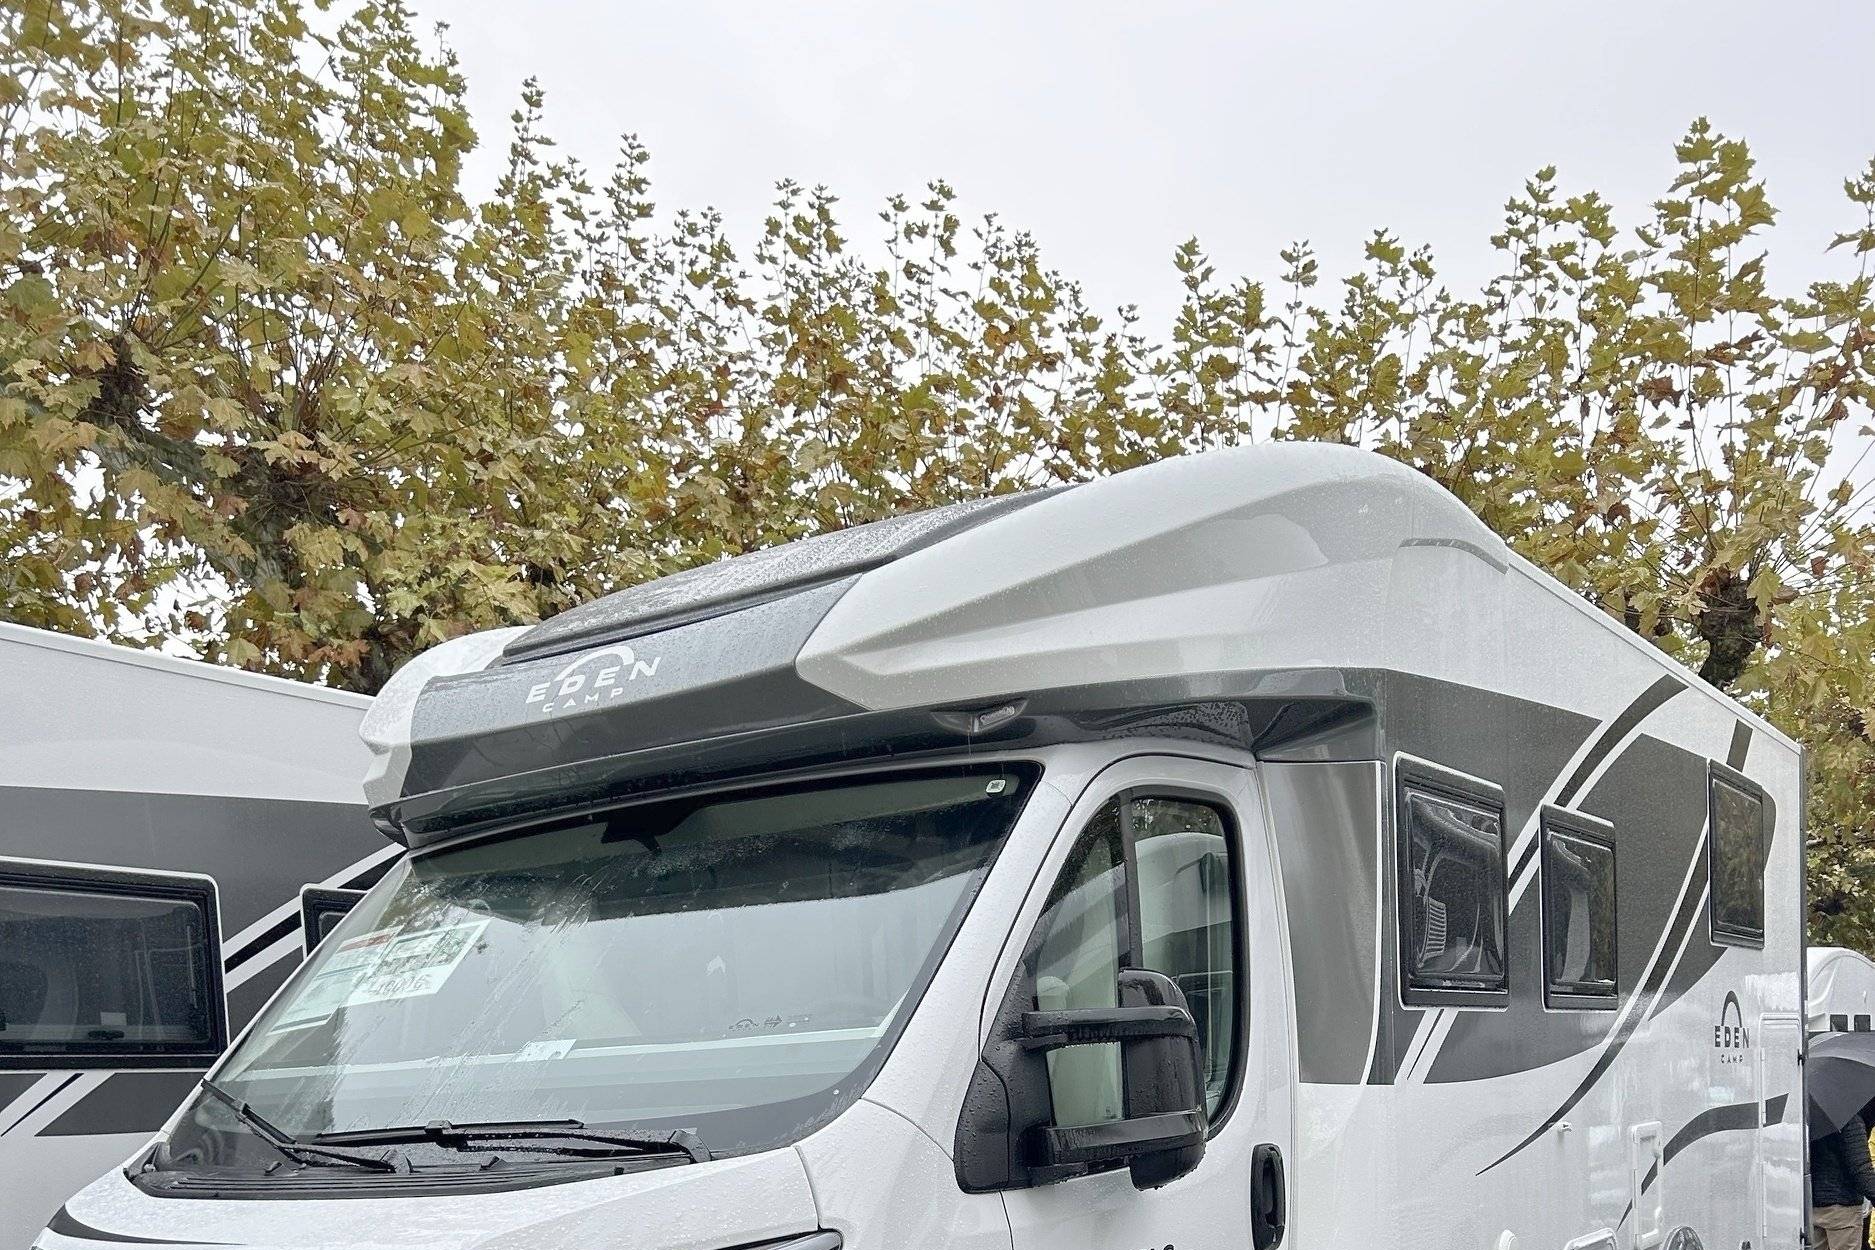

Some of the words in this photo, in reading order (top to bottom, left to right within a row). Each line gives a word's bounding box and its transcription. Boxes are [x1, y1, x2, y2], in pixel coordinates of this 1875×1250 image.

[525, 656, 661, 704] EDEN
[542, 686, 624, 713] CAMP
[1714, 1025, 1749, 1048] EDEN
[1720, 1054, 1743, 1064] CAMP
